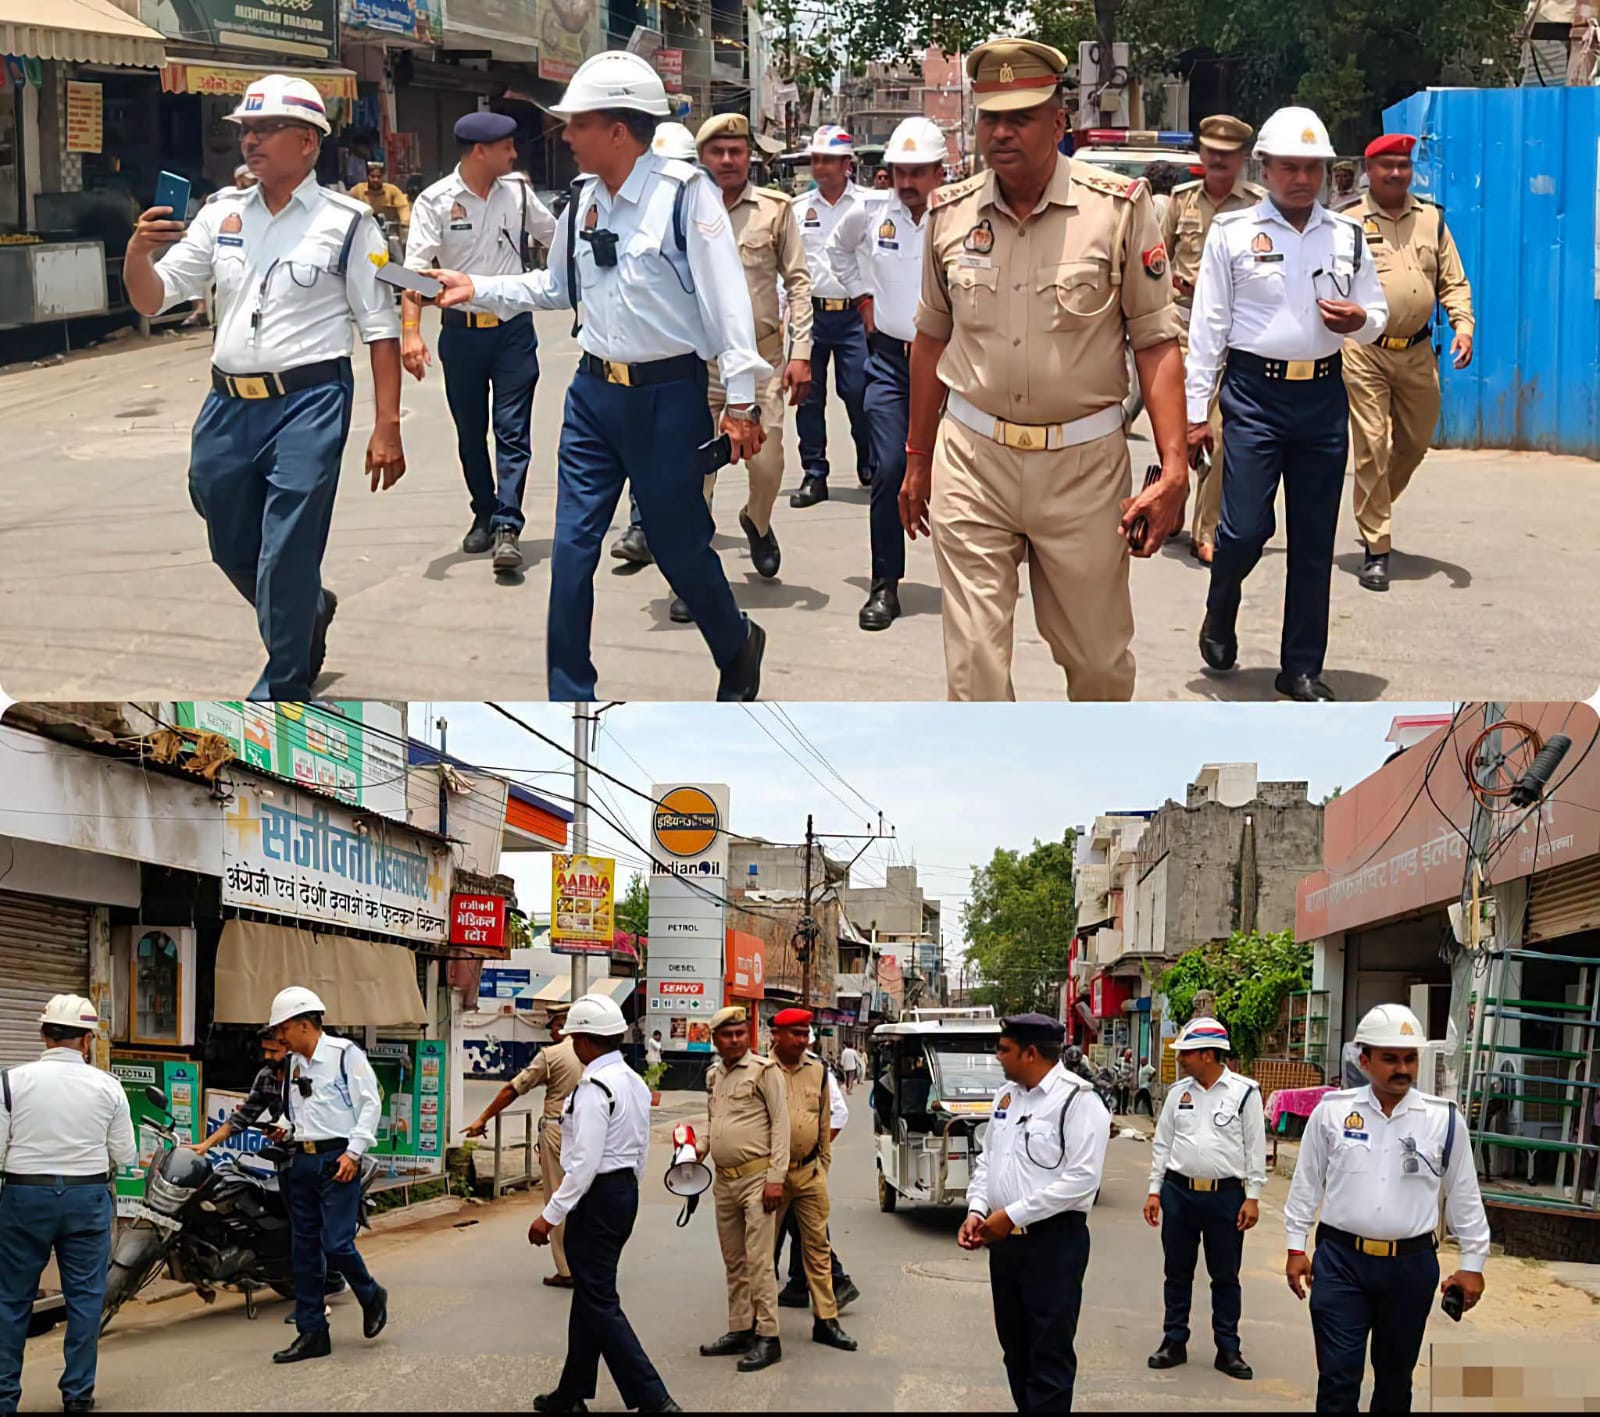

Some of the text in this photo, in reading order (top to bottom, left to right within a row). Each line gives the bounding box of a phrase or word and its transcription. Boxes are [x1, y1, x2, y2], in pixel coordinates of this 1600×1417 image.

[457, 911, 496, 928] मेडिकल
[667, 924, 699, 932] PETROL
[668, 964, 696, 972] DIESEL
[663, 984, 699, 993] SERVO
